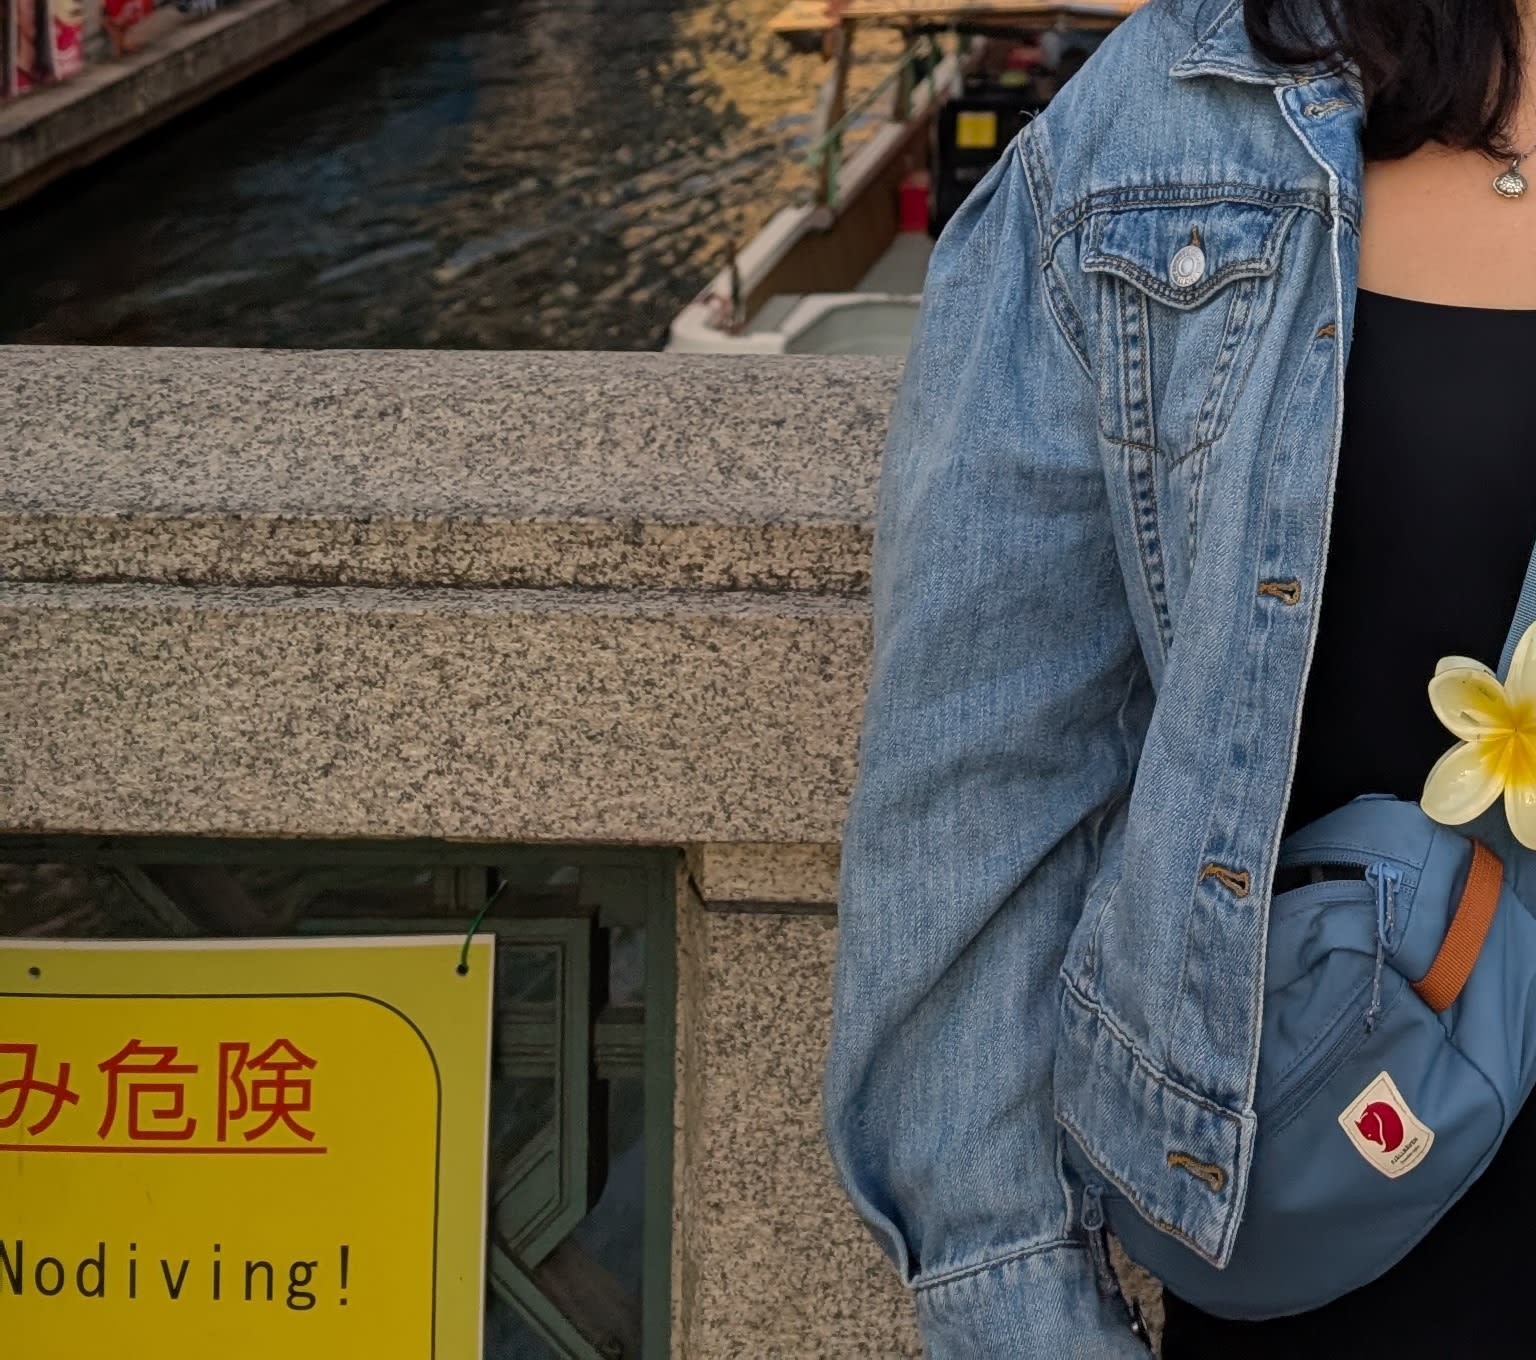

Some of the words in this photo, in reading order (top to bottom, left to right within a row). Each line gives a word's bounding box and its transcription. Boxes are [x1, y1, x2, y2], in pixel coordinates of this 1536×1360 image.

[0, 1038, 318, 1143] み危険
[0, 1239, 351, 1312] Nodiving!
